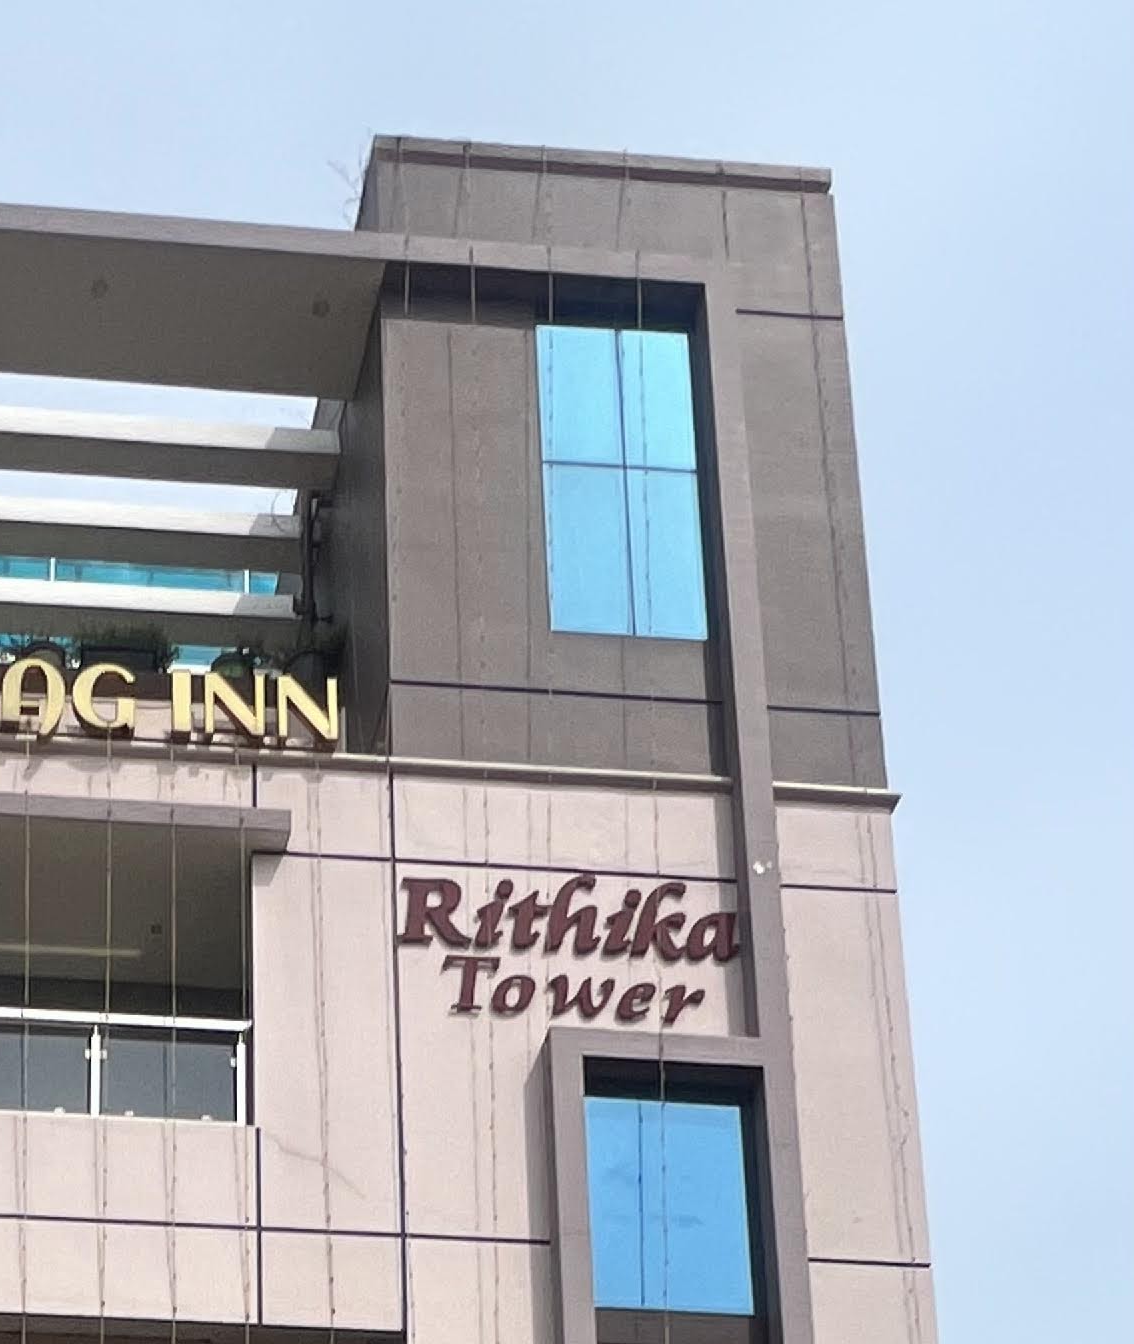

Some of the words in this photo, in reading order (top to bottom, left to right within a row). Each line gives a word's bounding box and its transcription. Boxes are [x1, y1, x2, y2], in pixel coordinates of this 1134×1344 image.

[171, 668, 340, 741] INN
[397, 874, 740, 963] Rithika
[441, 954, 706, 1026] Tower
